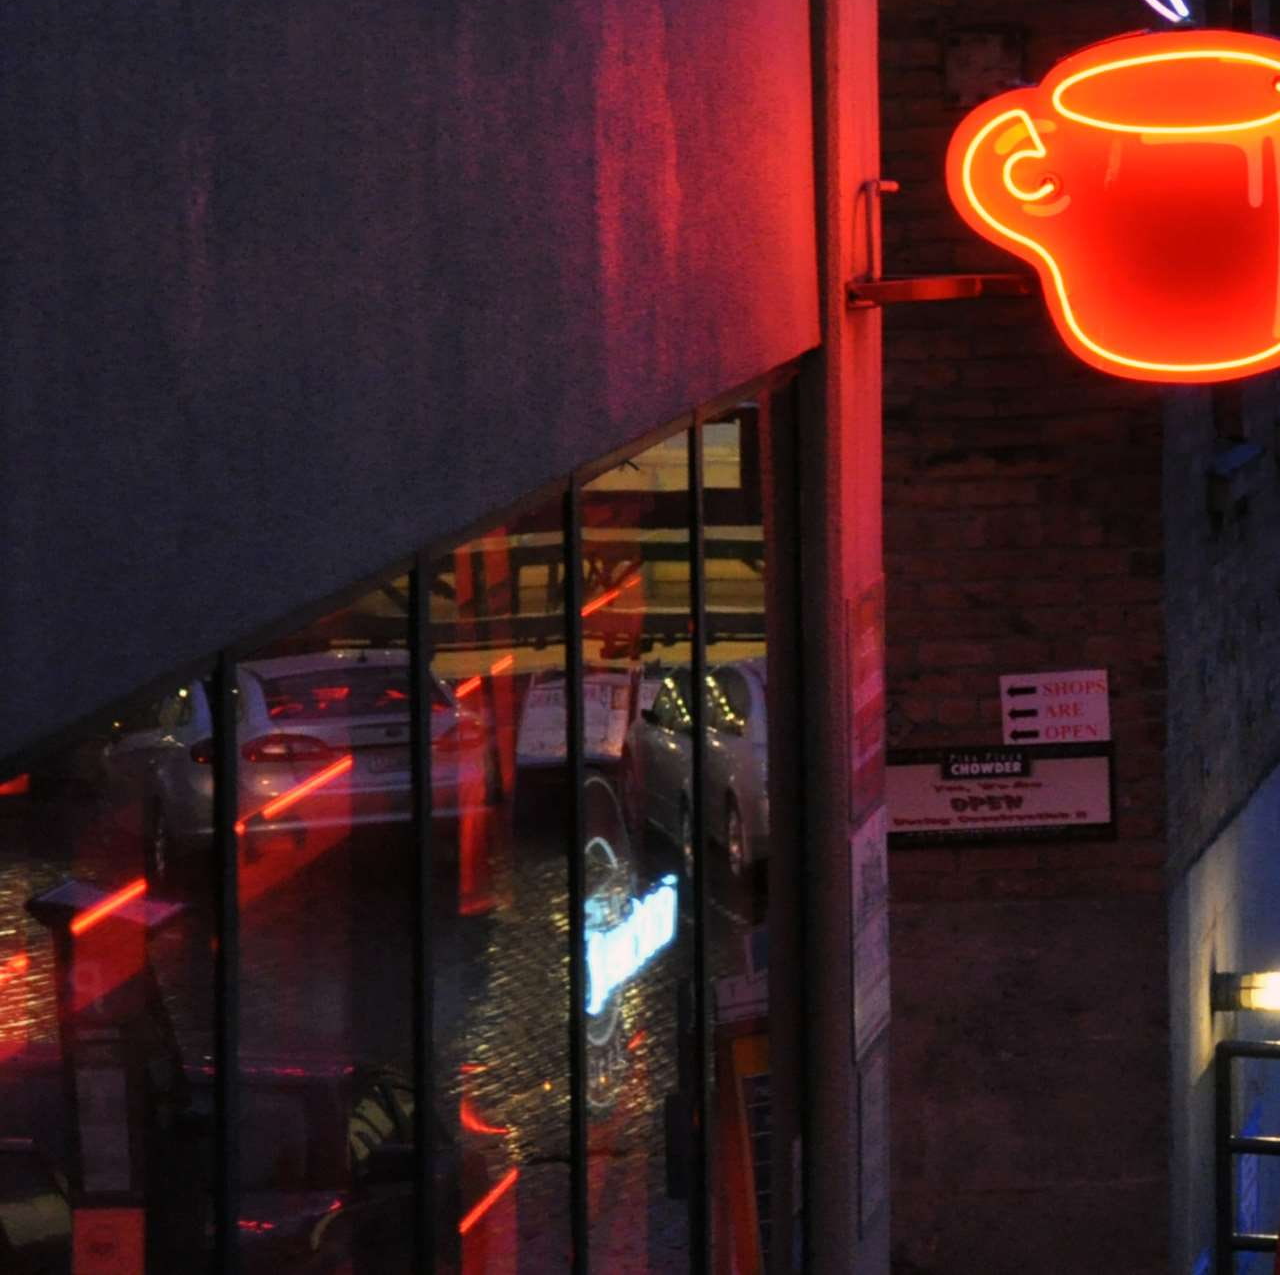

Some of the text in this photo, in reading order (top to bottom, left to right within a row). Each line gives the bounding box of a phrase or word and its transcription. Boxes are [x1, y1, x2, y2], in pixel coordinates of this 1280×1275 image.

[1042, 680, 1106, 696] SHOPS
[1046, 701, 1085, 718] ARE
[1045, 724, 1097, 740] OPEN
[950, 761, 1023, 776] CHOWDER
[950, 795, 1024, 812] OPEN
